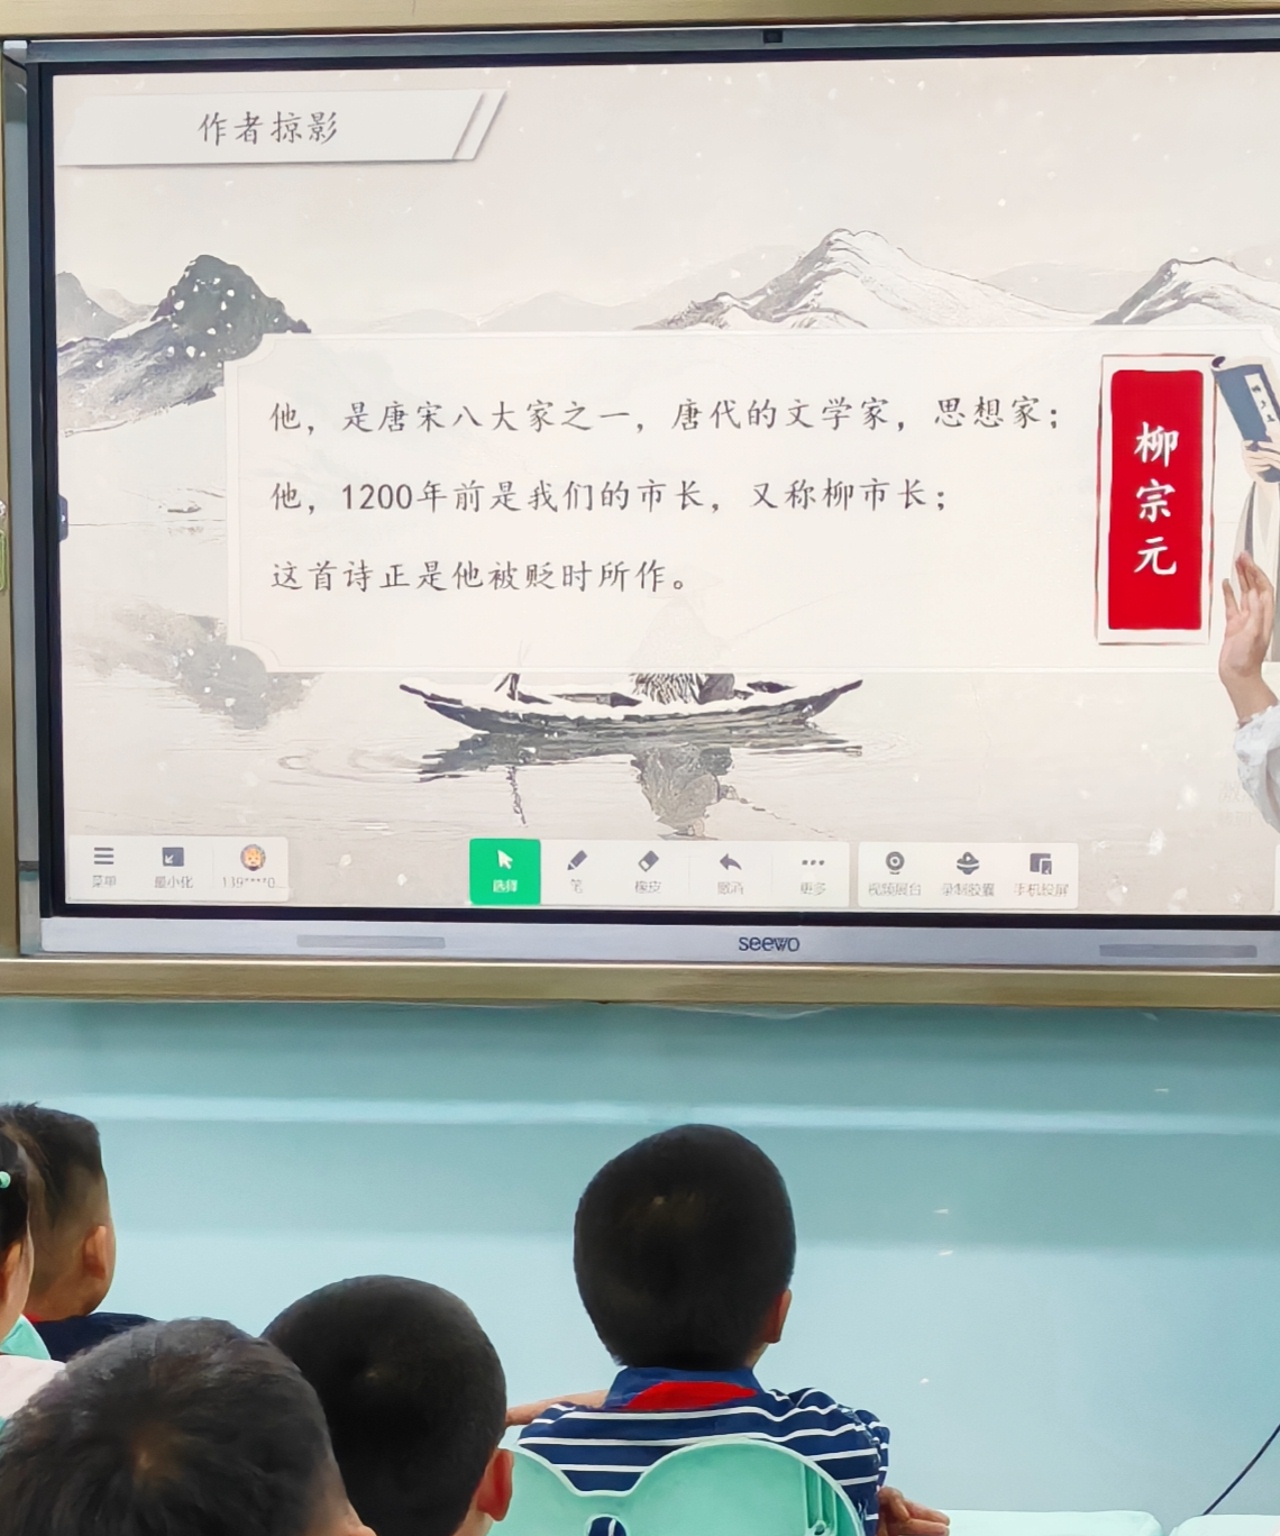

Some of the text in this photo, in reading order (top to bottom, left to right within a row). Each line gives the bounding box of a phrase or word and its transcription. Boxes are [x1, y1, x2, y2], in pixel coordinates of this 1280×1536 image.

[198, 110, 339, 146] 作者掠影
[1133, 420, 1180, 577] 柳宗元
[270, 558, 687, 593] 这首诗正是他被贬时所作。
[492, 879, 518, 893] 选择
[800, 882, 827, 896] 更多
[738, 936, 801, 953] seewo
